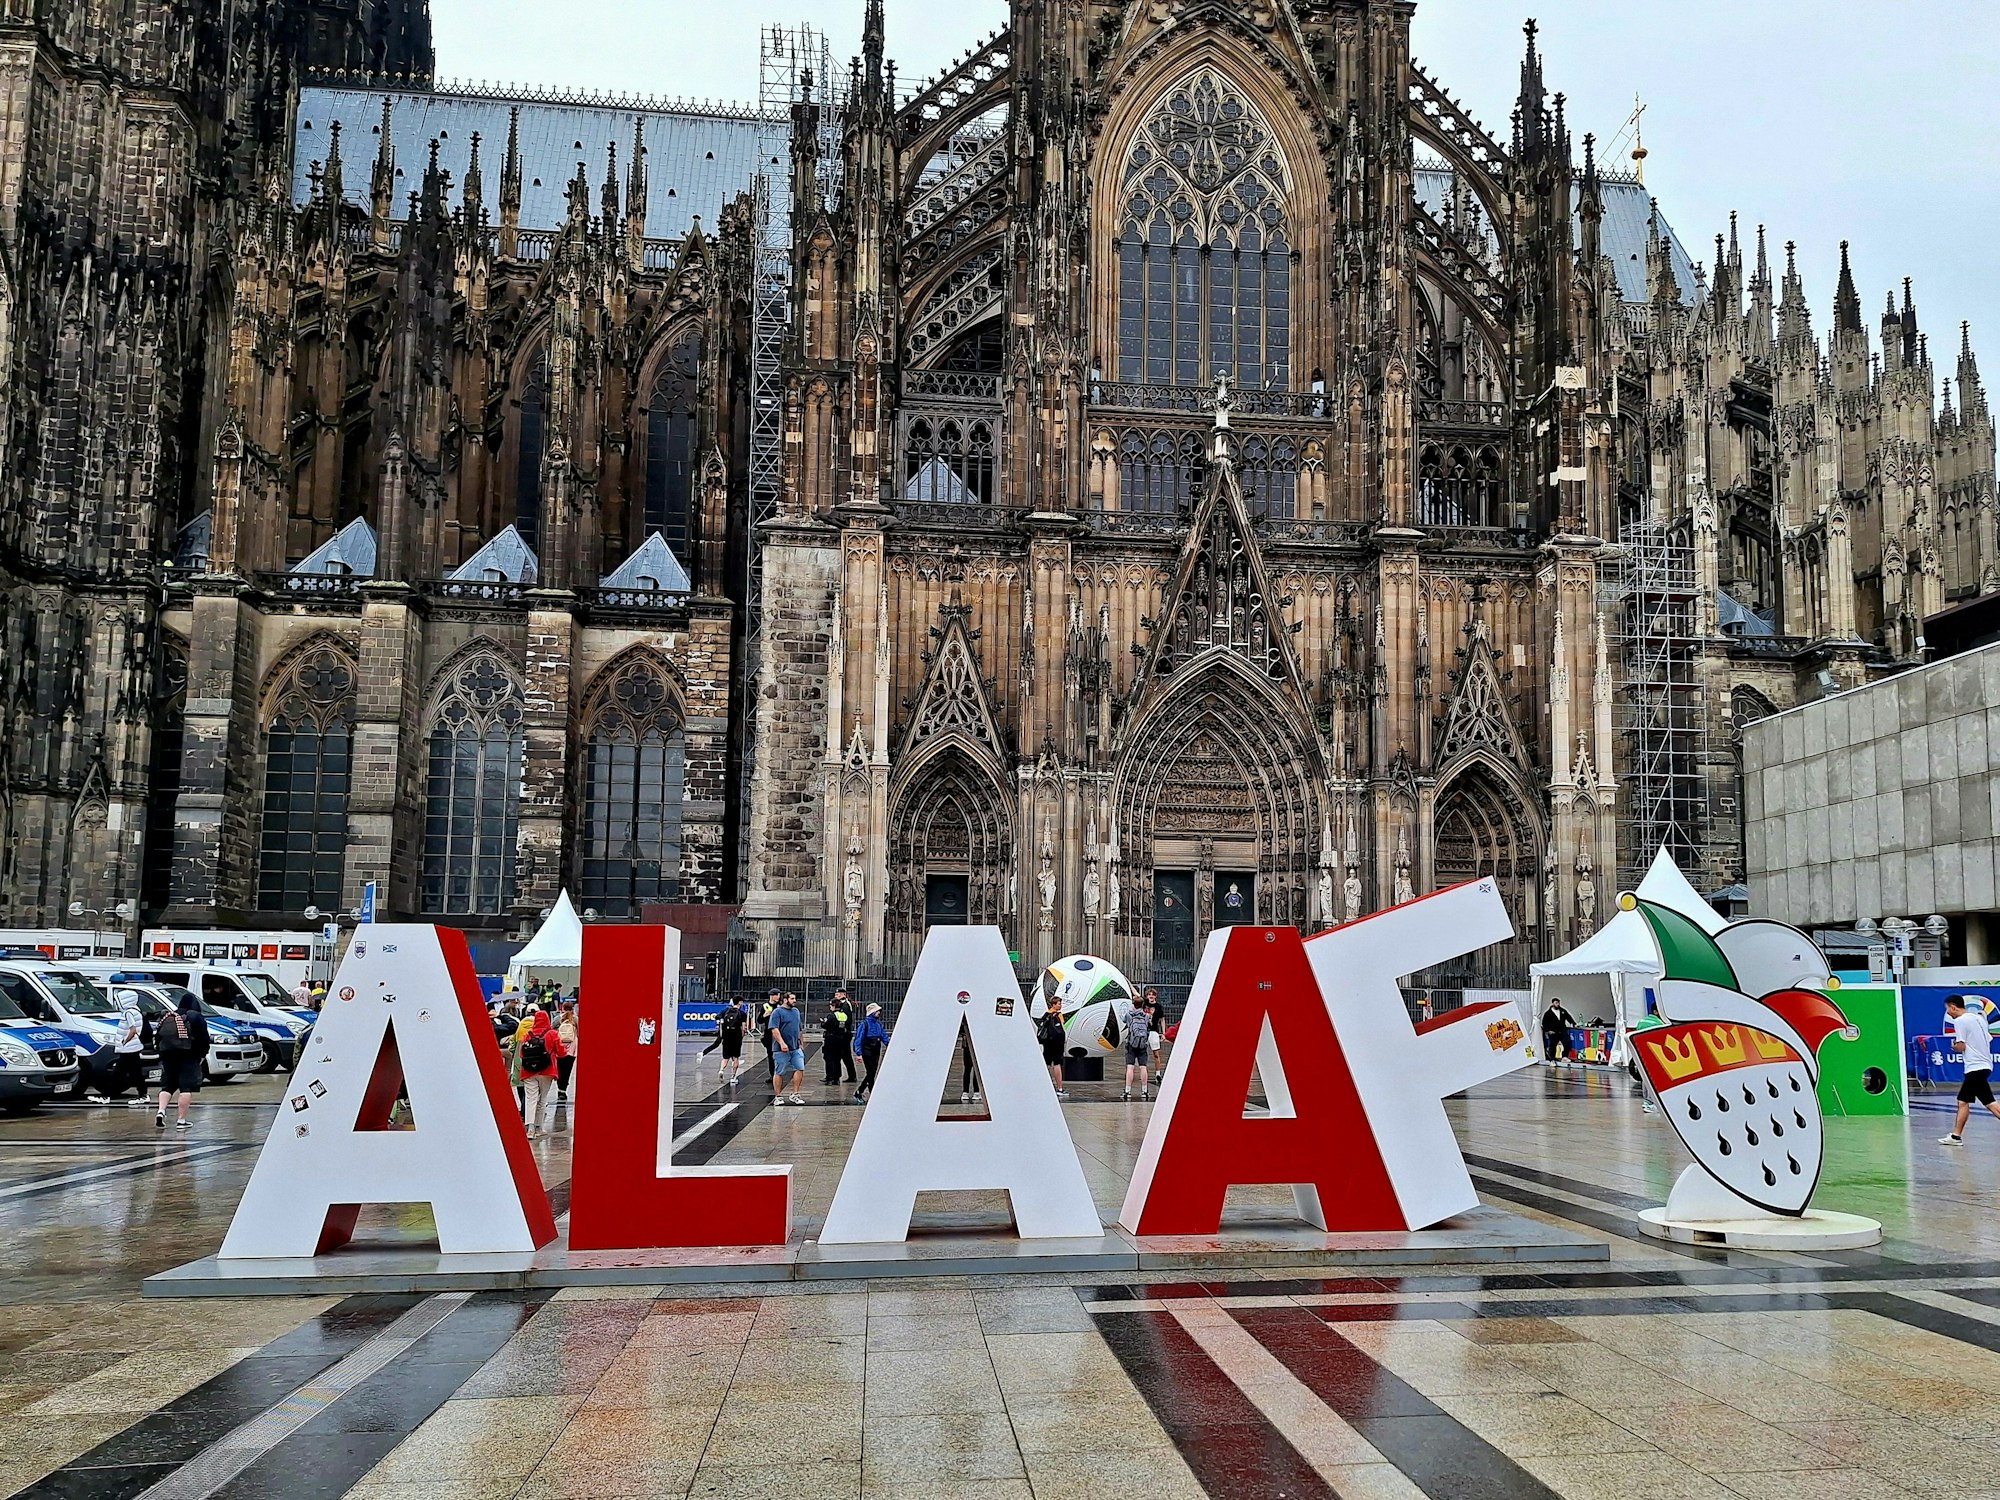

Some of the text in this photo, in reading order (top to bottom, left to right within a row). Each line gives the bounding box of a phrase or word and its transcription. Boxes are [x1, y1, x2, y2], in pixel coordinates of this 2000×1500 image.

[183, 945, 198, 957] WC
[234, 945, 248, 957] WC
[683, 1013, 718, 1021] COLOG
[28, 1032, 63, 1041] POLIZEI
[1947, 1054, 1963, 1063] UE
[218, 876, 1537, 1259] ALAAF
